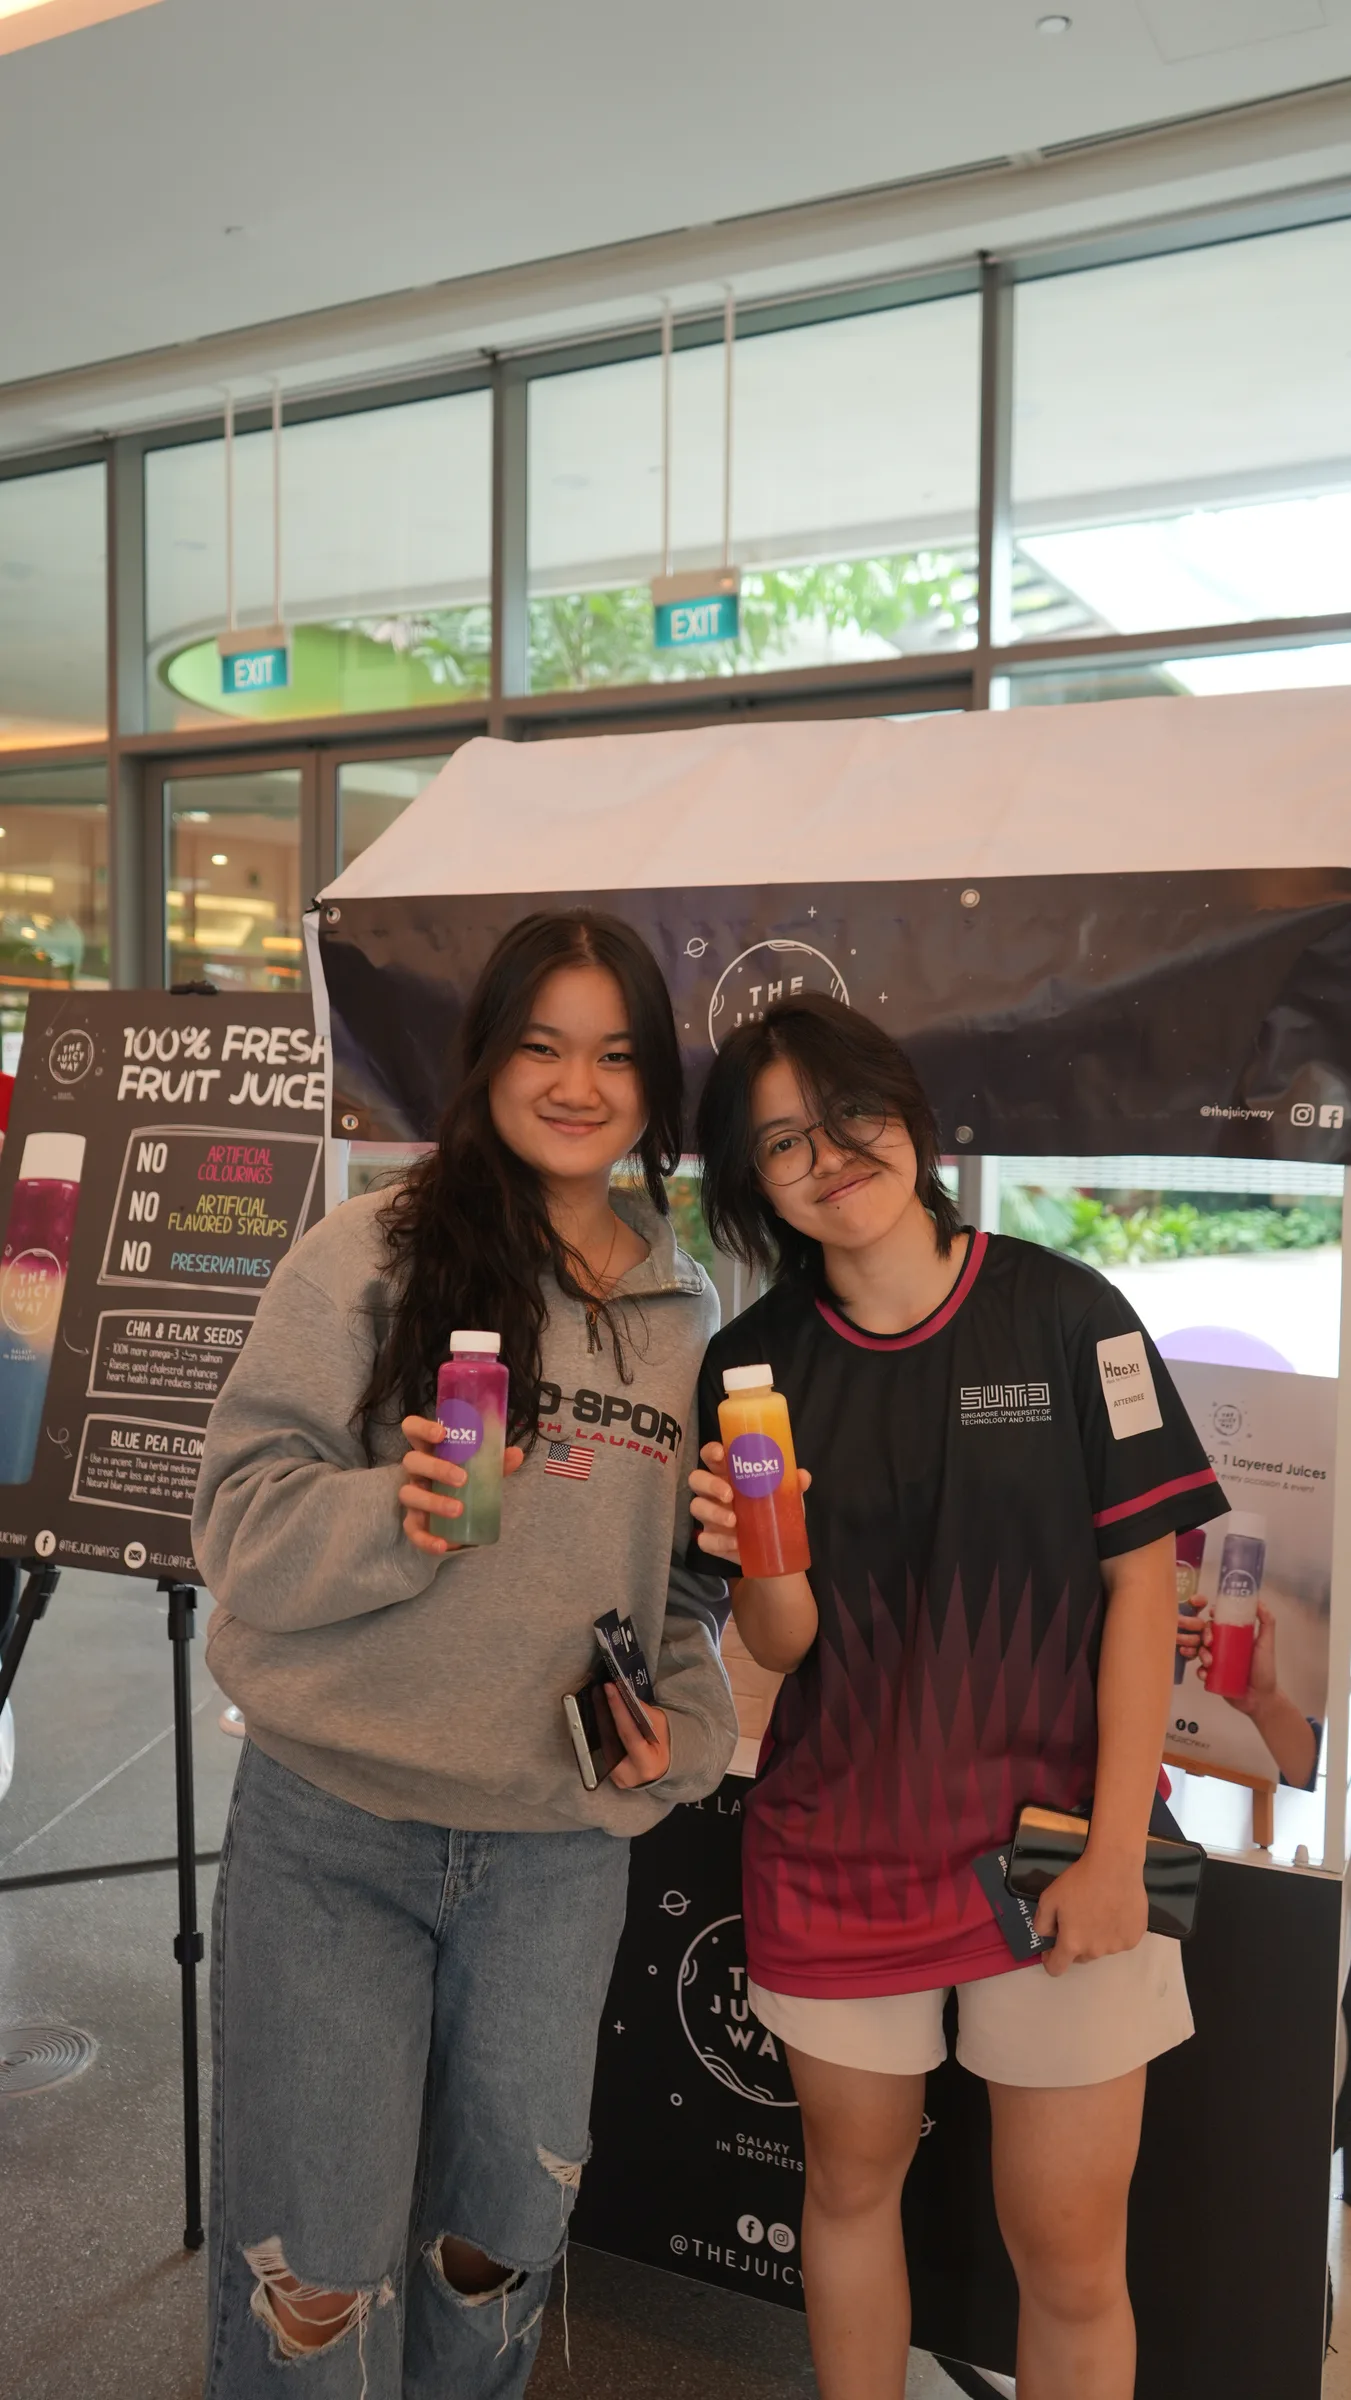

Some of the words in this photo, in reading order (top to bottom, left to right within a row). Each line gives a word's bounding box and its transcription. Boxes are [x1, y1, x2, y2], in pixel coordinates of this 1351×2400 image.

[671, 603, 722, 641] EXIT
[234, 655, 274, 687] EXIT
[749, 976, 803, 1006] THE
[63, 1042, 81, 1054] THE
[124, 1026, 211, 1062] 100%
[57, 1051, 85, 1062] JUICY
[60, 1061, 79, 1072] WAY
[117, 1065, 221, 1103] FRUIT
[228, 1070, 325, 1110] JUICE
[1200, 1104, 1275, 1121] @thejuicyway
[136, 1142, 168, 1173] NO
[207, 1146, 273, 1166] ARTIFICIAL
[197, 1164, 273, 1184] COLOURINGS
[128, 1190, 160, 1222] NO
[196, 1194, 269, 1218] ARTIFICIAL
[167, 1212, 233, 1234] FLAVORED
[237, 1217, 288, 1238] SYRUPS
[120, 1240, 152, 1272] NO
[170, 1253, 271, 1277] PRESERVATIVES
[19, 1269, 47, 1285] THE
[14, 1301, 42, 1316] WAY
[126, 1320, 151, 1337] CHIA
[155, 1322, 164, 1339] &
[168, 1323, 200, 1342] FLAX
[204, 1326, 243, 1346] SEEDS
[1113, 1393, 1145, 1408] ATTENDEE
[960, 1410, 998, 1419] SINGAPORE
[1000, 1408, 1040, 1417] UNIVERSITY
[961, 1416, 1007, 1426] TECHNOLOGY
[1026, 1415, 1052, 1423] DESIGN
[110, 1430, 141, 1449] BLUE
[145, 1434, 168, 1452] PEA
[575, 1428, 668, 1464] LAUREN
[1207, 1454, 1218, 1464] o.
[1223, 1454, 1228, 1465] 1
[1232, 1455, 1283, 1473] Layered
[1286, 1464, 1327, 1480] Juices
[716, 2140, 731, 2152] IN
[737, 2146, 804, 2171] DROPLETS
[736, 2133, 790, 2154] GALAXY
